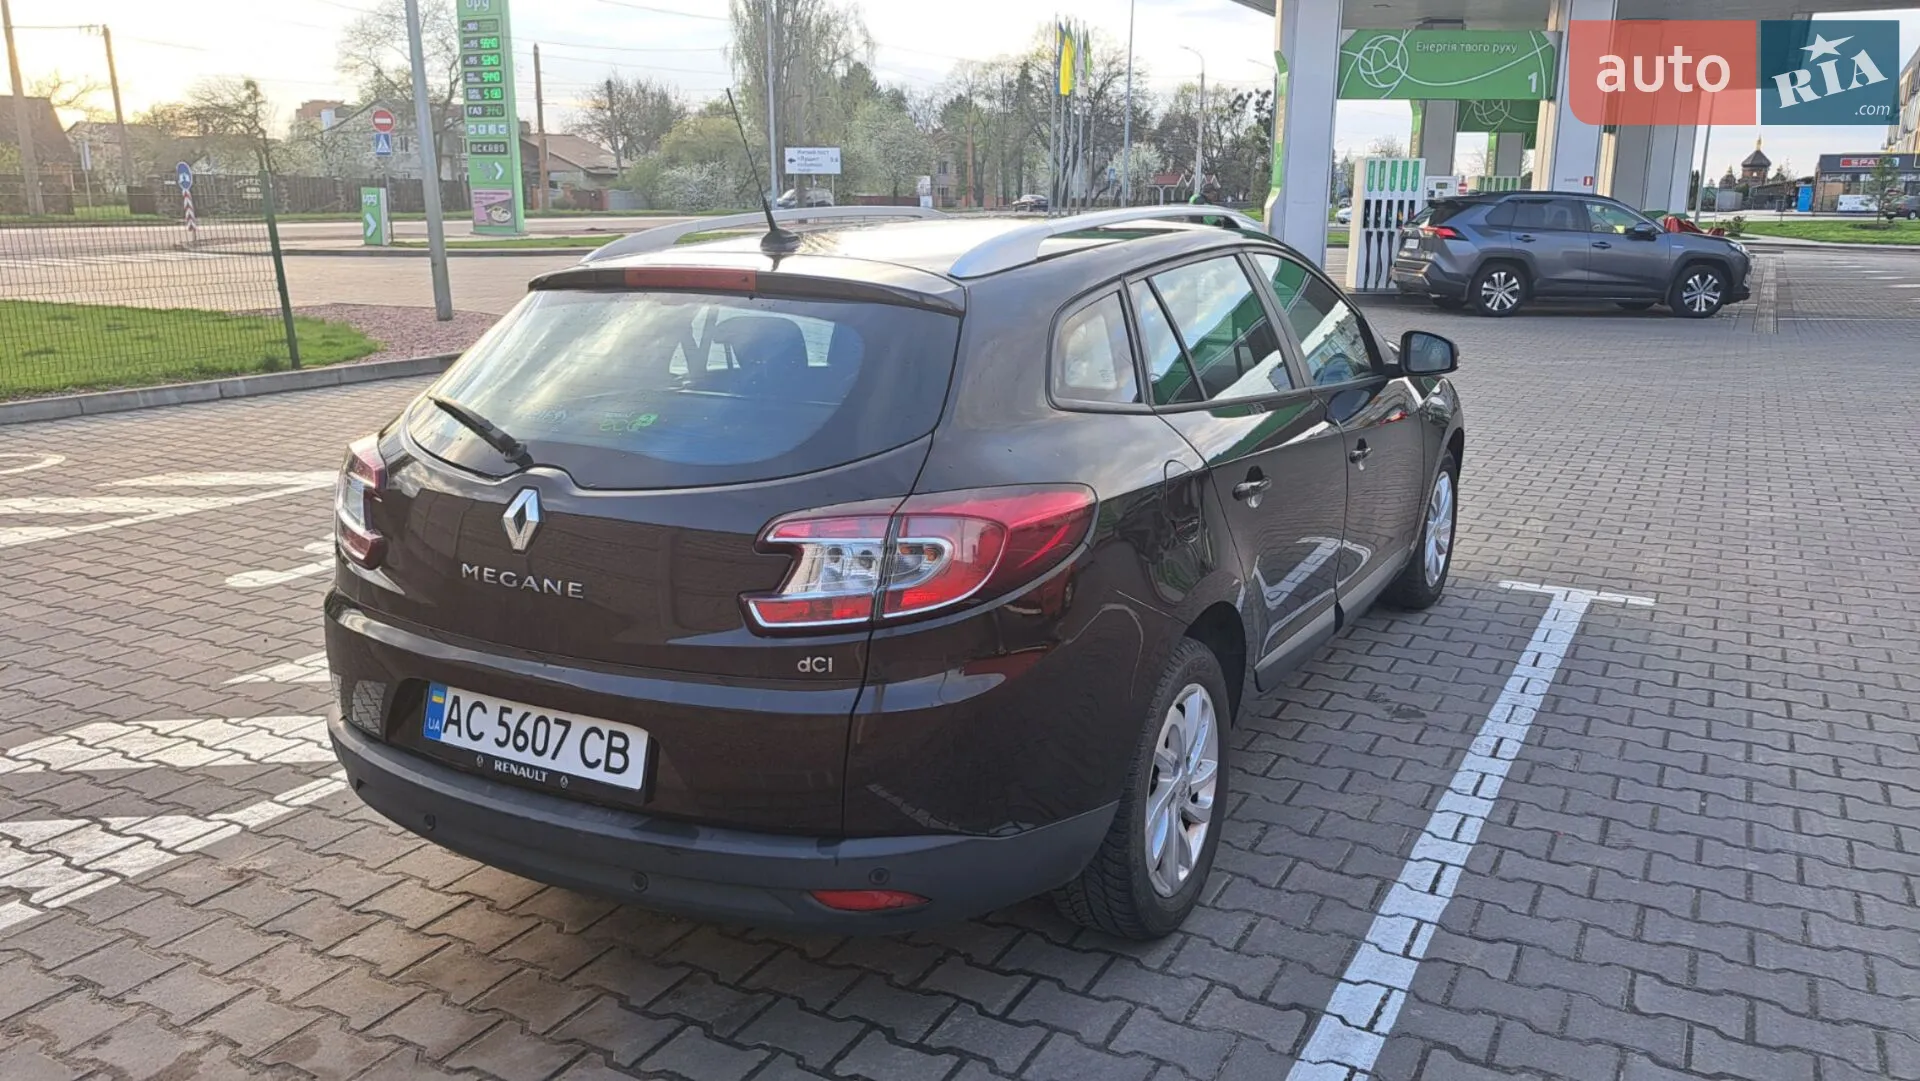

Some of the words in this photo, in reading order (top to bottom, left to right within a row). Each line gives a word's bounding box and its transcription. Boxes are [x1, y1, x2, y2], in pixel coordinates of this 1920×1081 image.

[1416, 41, 1457, 53] Енергія
[1459, 43, 1490, 52] твого
[1492, 43, 1518, 54] руху
[1527, 71, 1538, 93] 1
[468, 106, 483, 115] ГАЗ
[461, 562, 585, 600] MEGANE
[428, 717, 441, 732] UA
[443, 695, 488, 742] AC
[494, 705, 572, 761] 5607
[579, 726, 631, 775] CB
[493, 759, 549, 783] RENAULT
